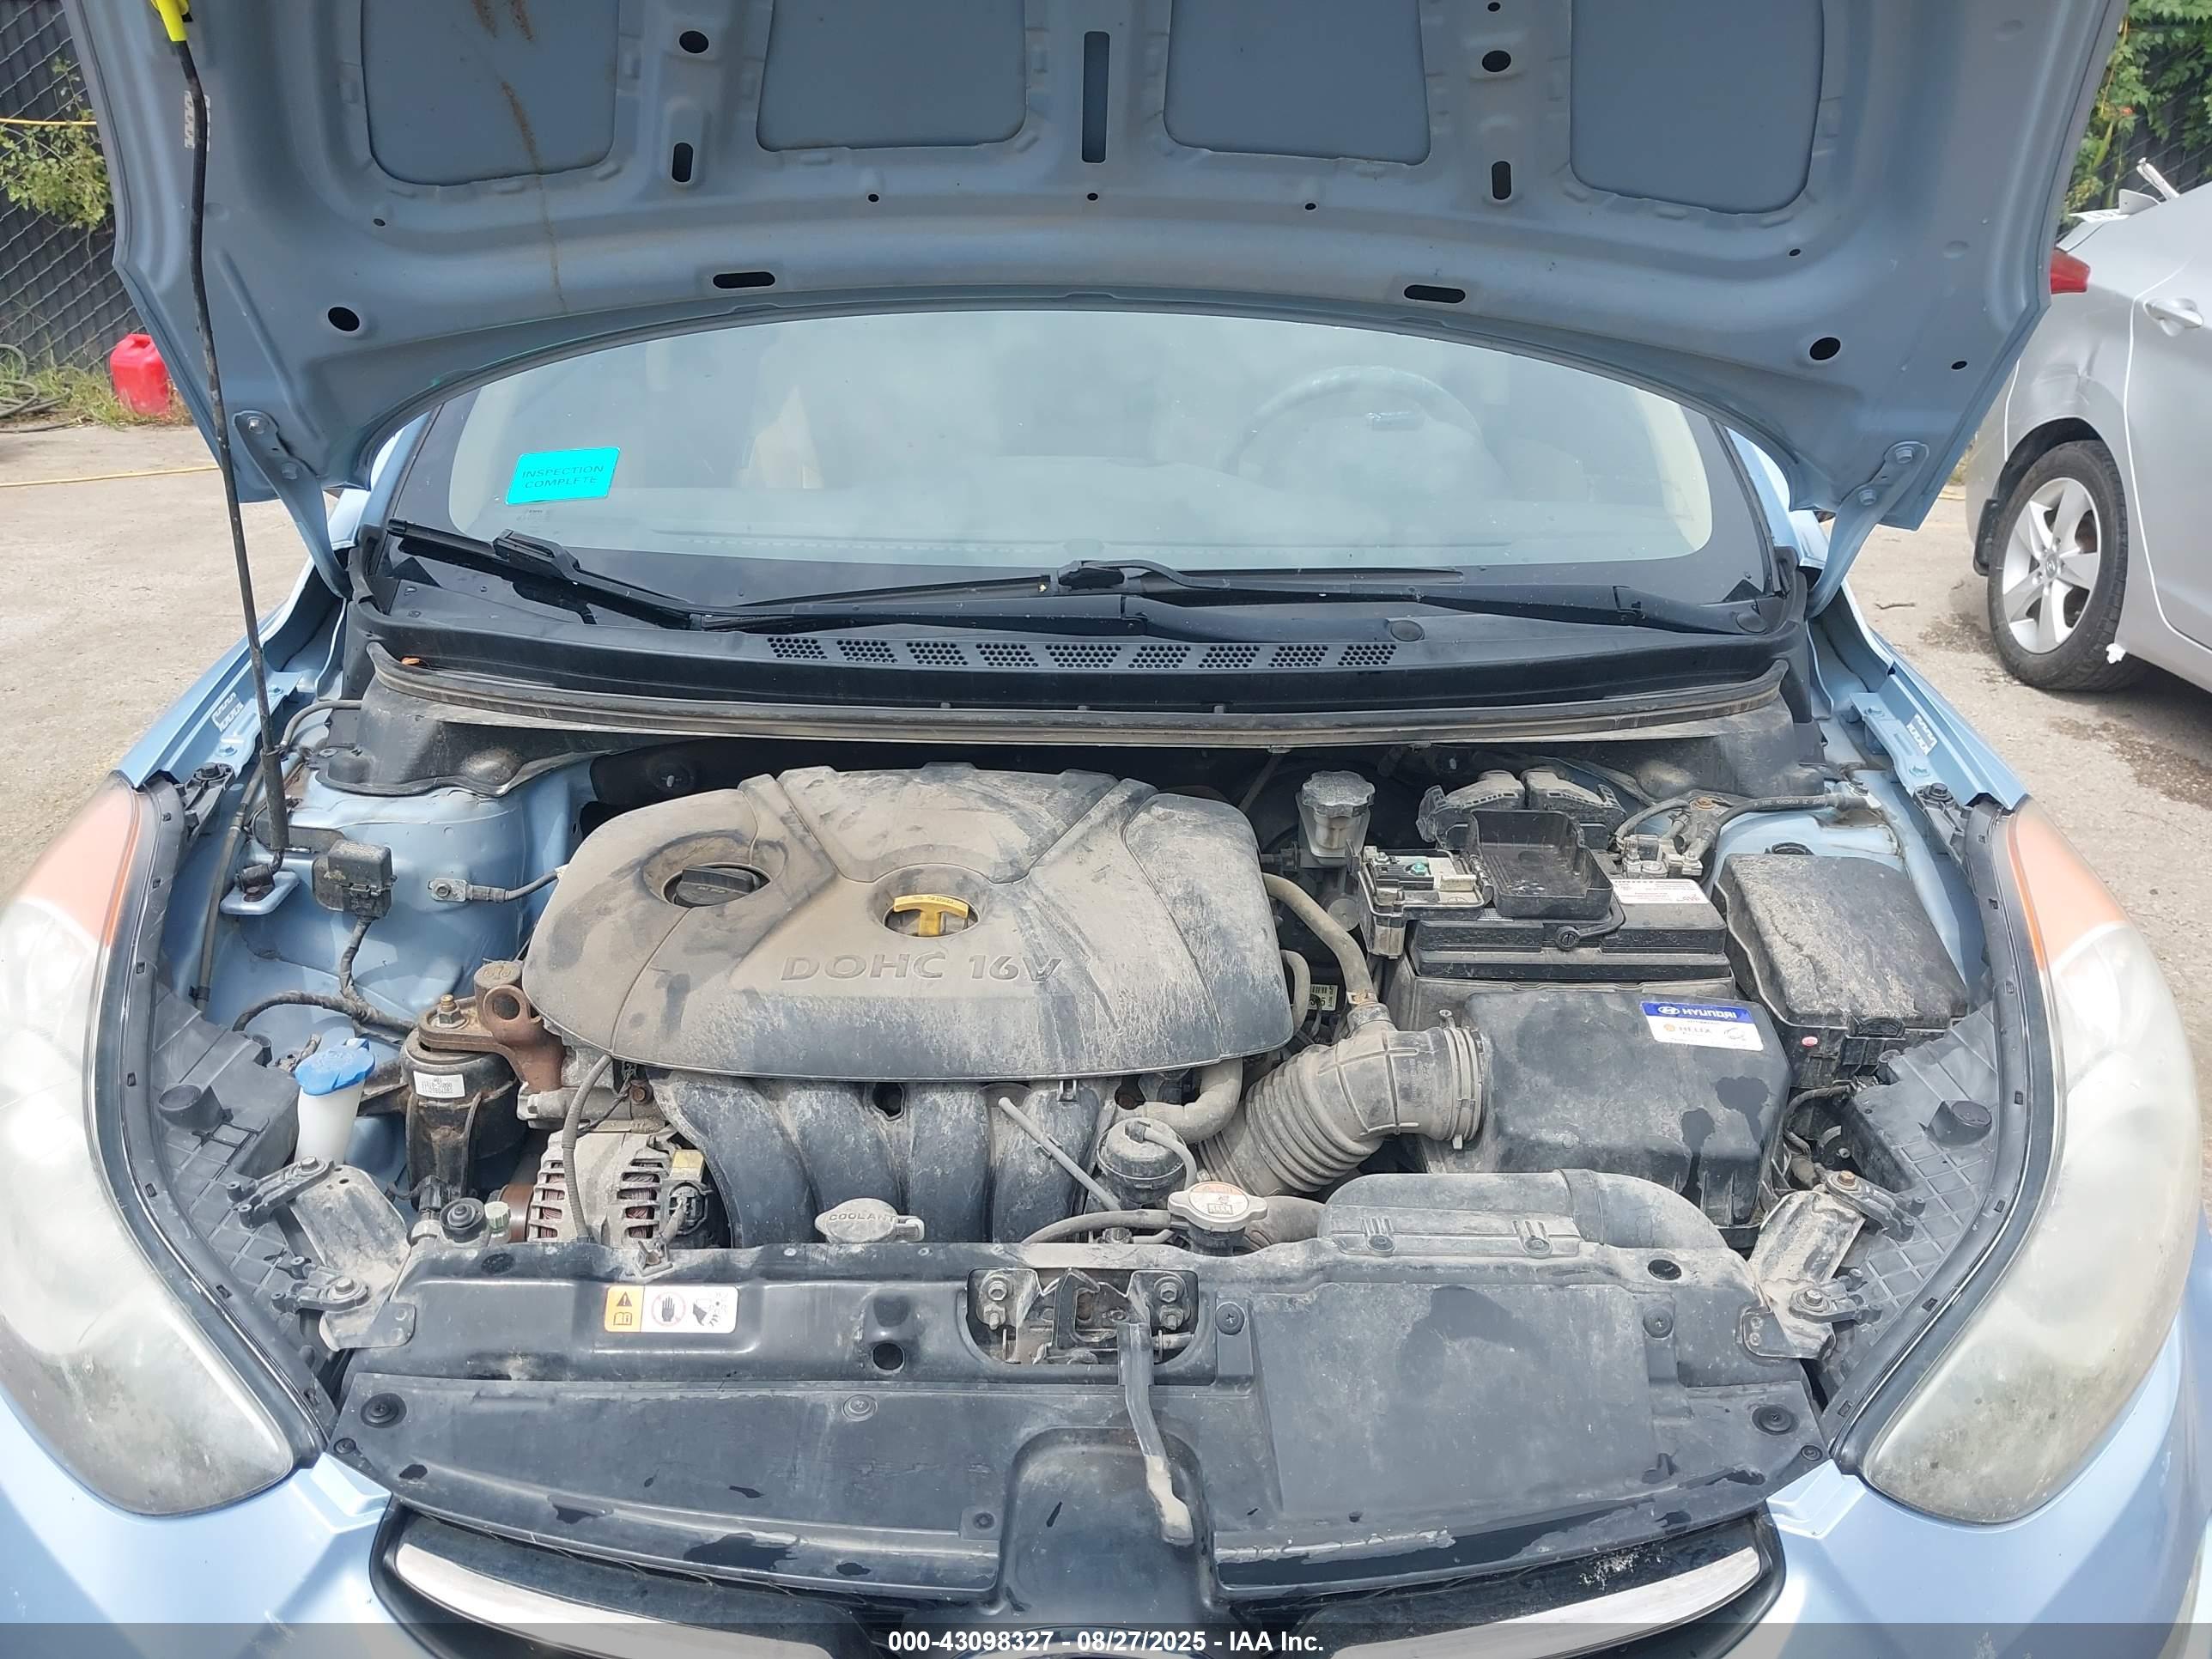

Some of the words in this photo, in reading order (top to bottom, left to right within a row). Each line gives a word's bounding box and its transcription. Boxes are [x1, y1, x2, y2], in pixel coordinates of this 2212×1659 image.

[522, 465, 605, 478] INSPECTION
[525, 476, 599, 489] COMPLETE
[780, 951, 946, 981] DOHC
[969, 953, 1062, 982] 16V
[1681, 1007, 1737, 1019] HYUNDAI
[829, 1212, 896, 1222] COOLANT
